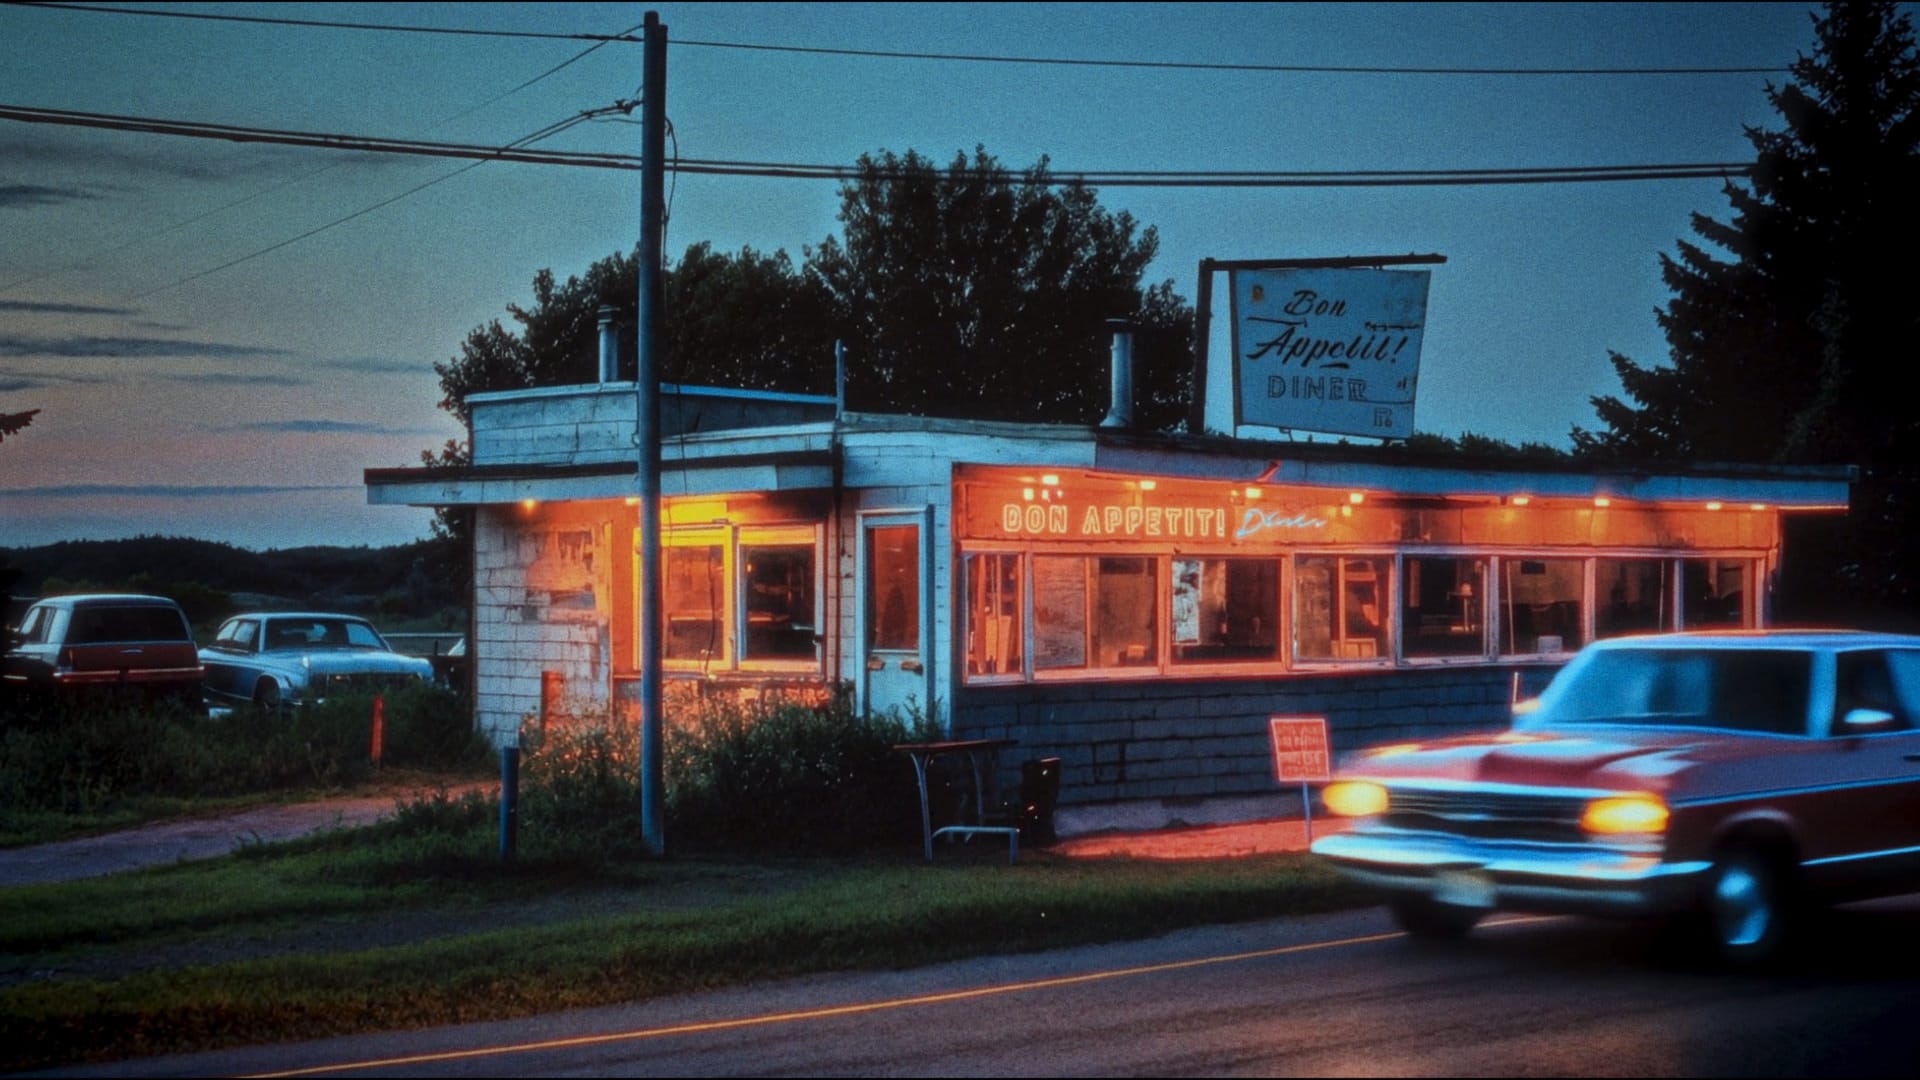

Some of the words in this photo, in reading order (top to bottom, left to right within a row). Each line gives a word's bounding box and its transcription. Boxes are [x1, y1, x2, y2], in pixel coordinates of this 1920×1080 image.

[1284, 289, 1346, 317] Bon
[1267, 375, 1367, 401] DINER
[1081, 504, 1226, 538] APPETIT!
